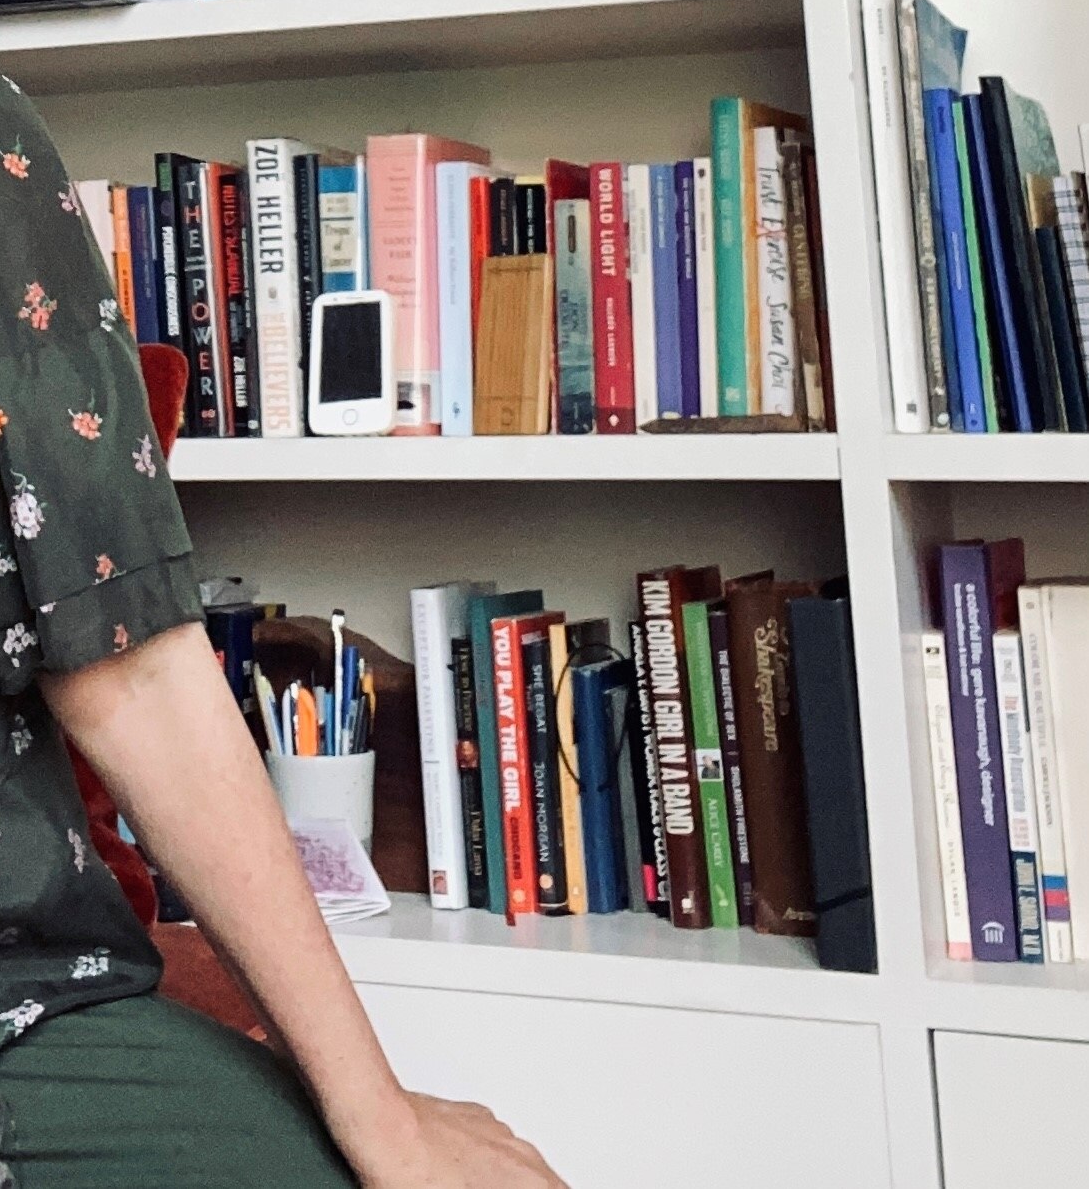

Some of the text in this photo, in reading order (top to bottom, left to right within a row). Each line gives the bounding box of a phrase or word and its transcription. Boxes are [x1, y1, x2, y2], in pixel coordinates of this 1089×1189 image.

[257, 194, 284, 274] HELLER
[597, 168, 618, 276] WORLD LIGHT
[758, 159, 781, 207] Trust
[185, 181, 214, 396] THE POWER
[262, 324, 290, 430] BELIEVERS
[765, 294, 787, 389] Susan Choi
[493, 624, 521, 812] YOU PLAY THE GIRL
[531, 663, 544, 689] SHE
[641, 578, 695, 836] KIM GORDON GIRL IN A BAND
[533, 761, 550, 862] JOAN MORGAN
